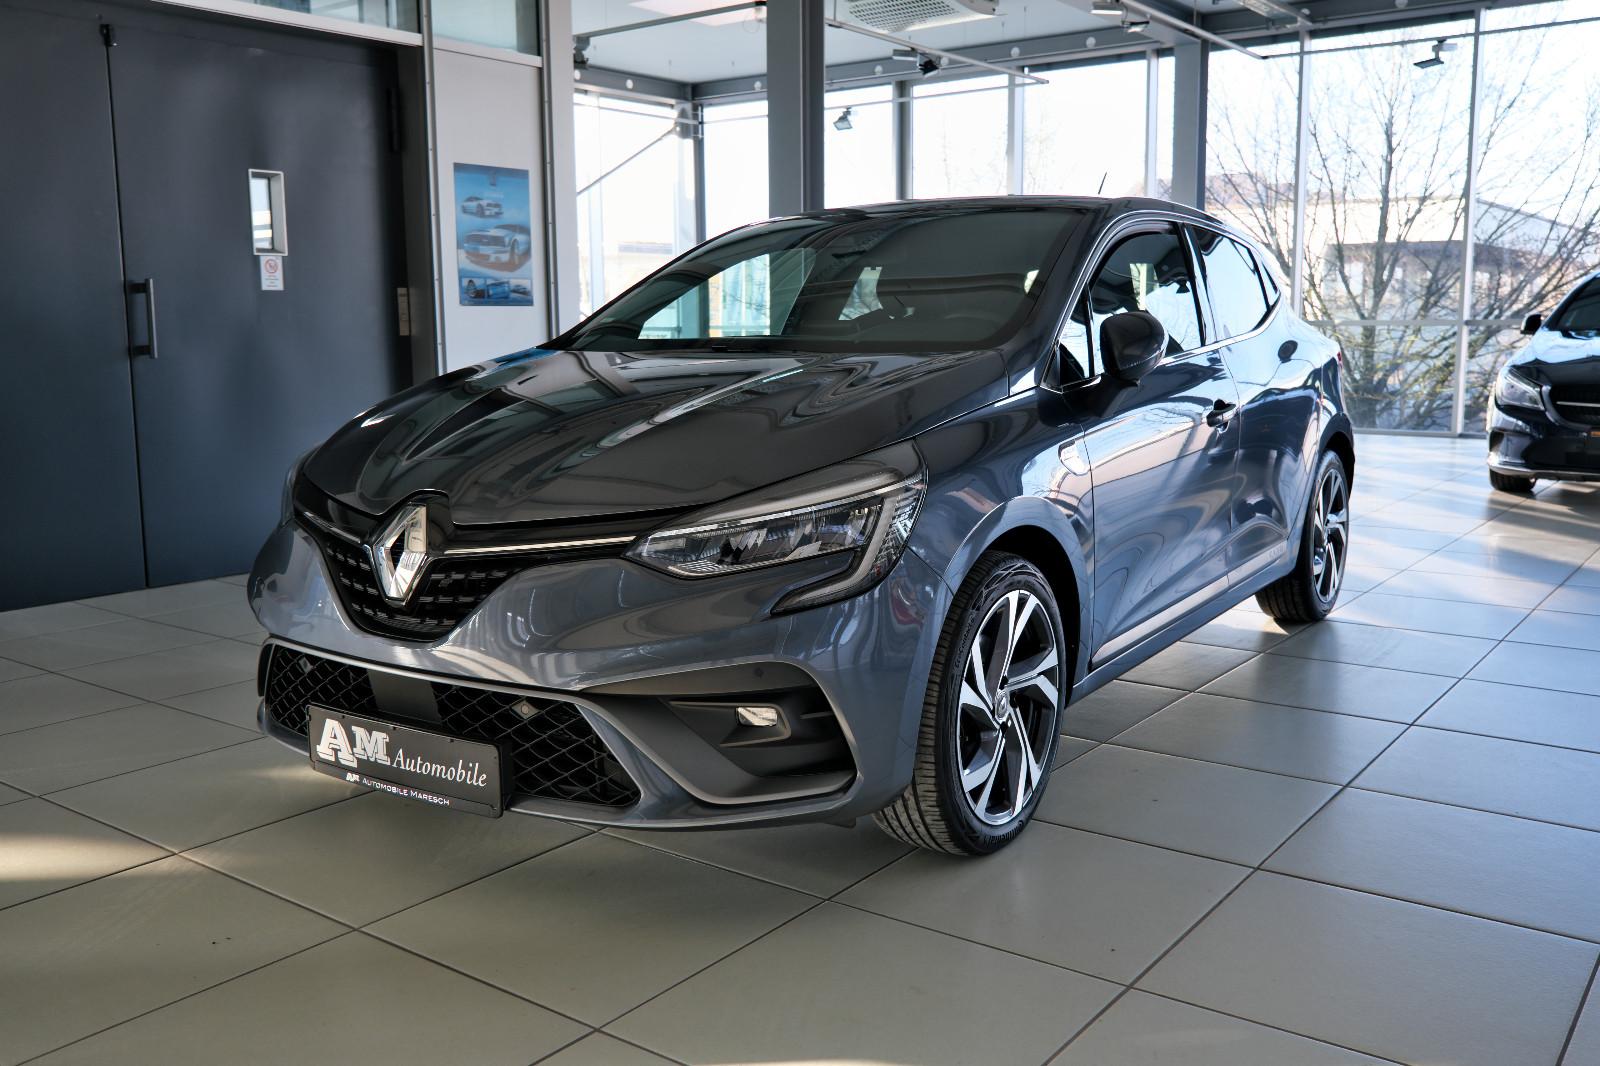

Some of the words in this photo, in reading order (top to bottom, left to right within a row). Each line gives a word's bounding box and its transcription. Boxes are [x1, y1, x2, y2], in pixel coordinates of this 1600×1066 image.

[316, 718, 391, 768] AM
[393, 747, 488, 787] Automobile
[362, 777, 409, 797] AUTOMOBILE
[410, 790, 451, 806] MARESCH
